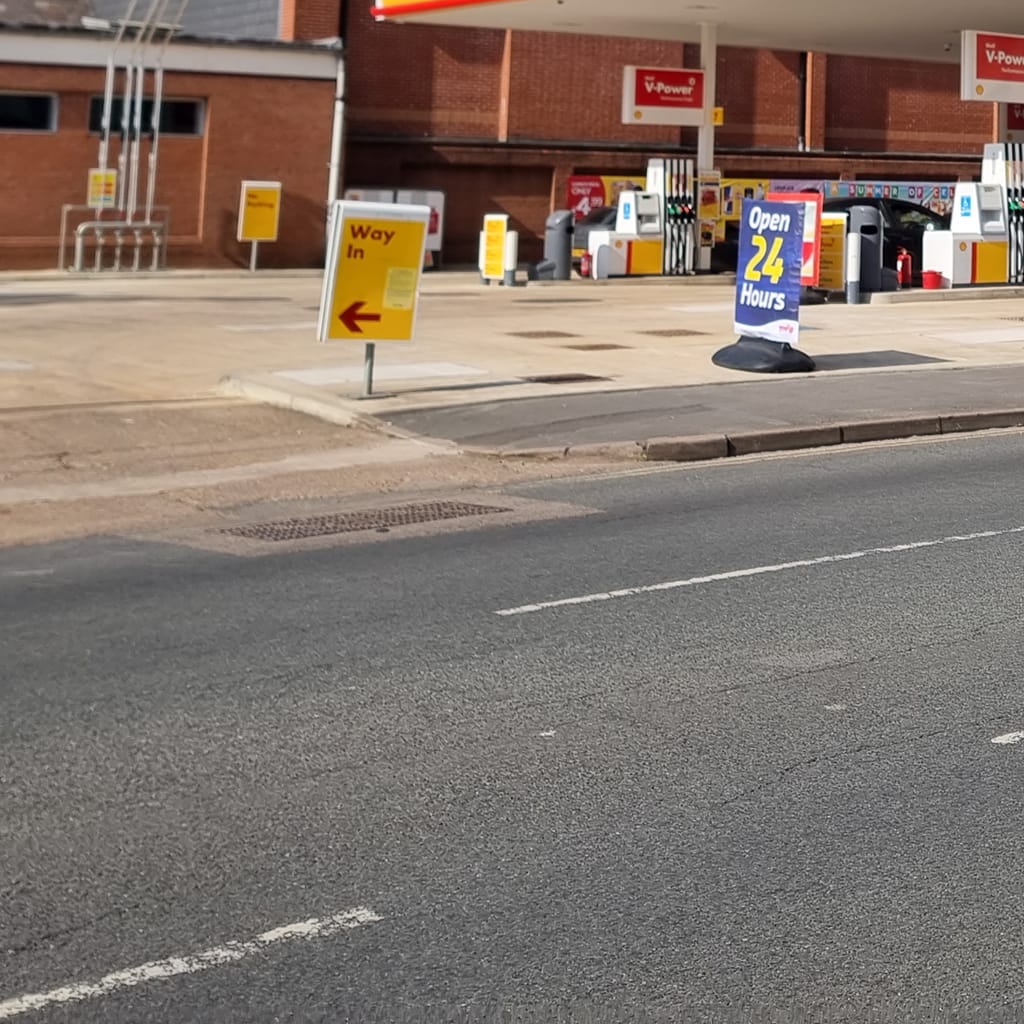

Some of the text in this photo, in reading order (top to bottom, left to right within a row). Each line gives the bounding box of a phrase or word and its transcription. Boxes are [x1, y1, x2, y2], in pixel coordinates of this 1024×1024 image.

[644, 81, 694, 95] V-Power
[749, 206, 791, 234] Open
[350, 223, 396, 246] Way
[347, 243, 366, 259] In
[744, 234, 784, 284] 24
[740, 283, 786, 311] Hours
